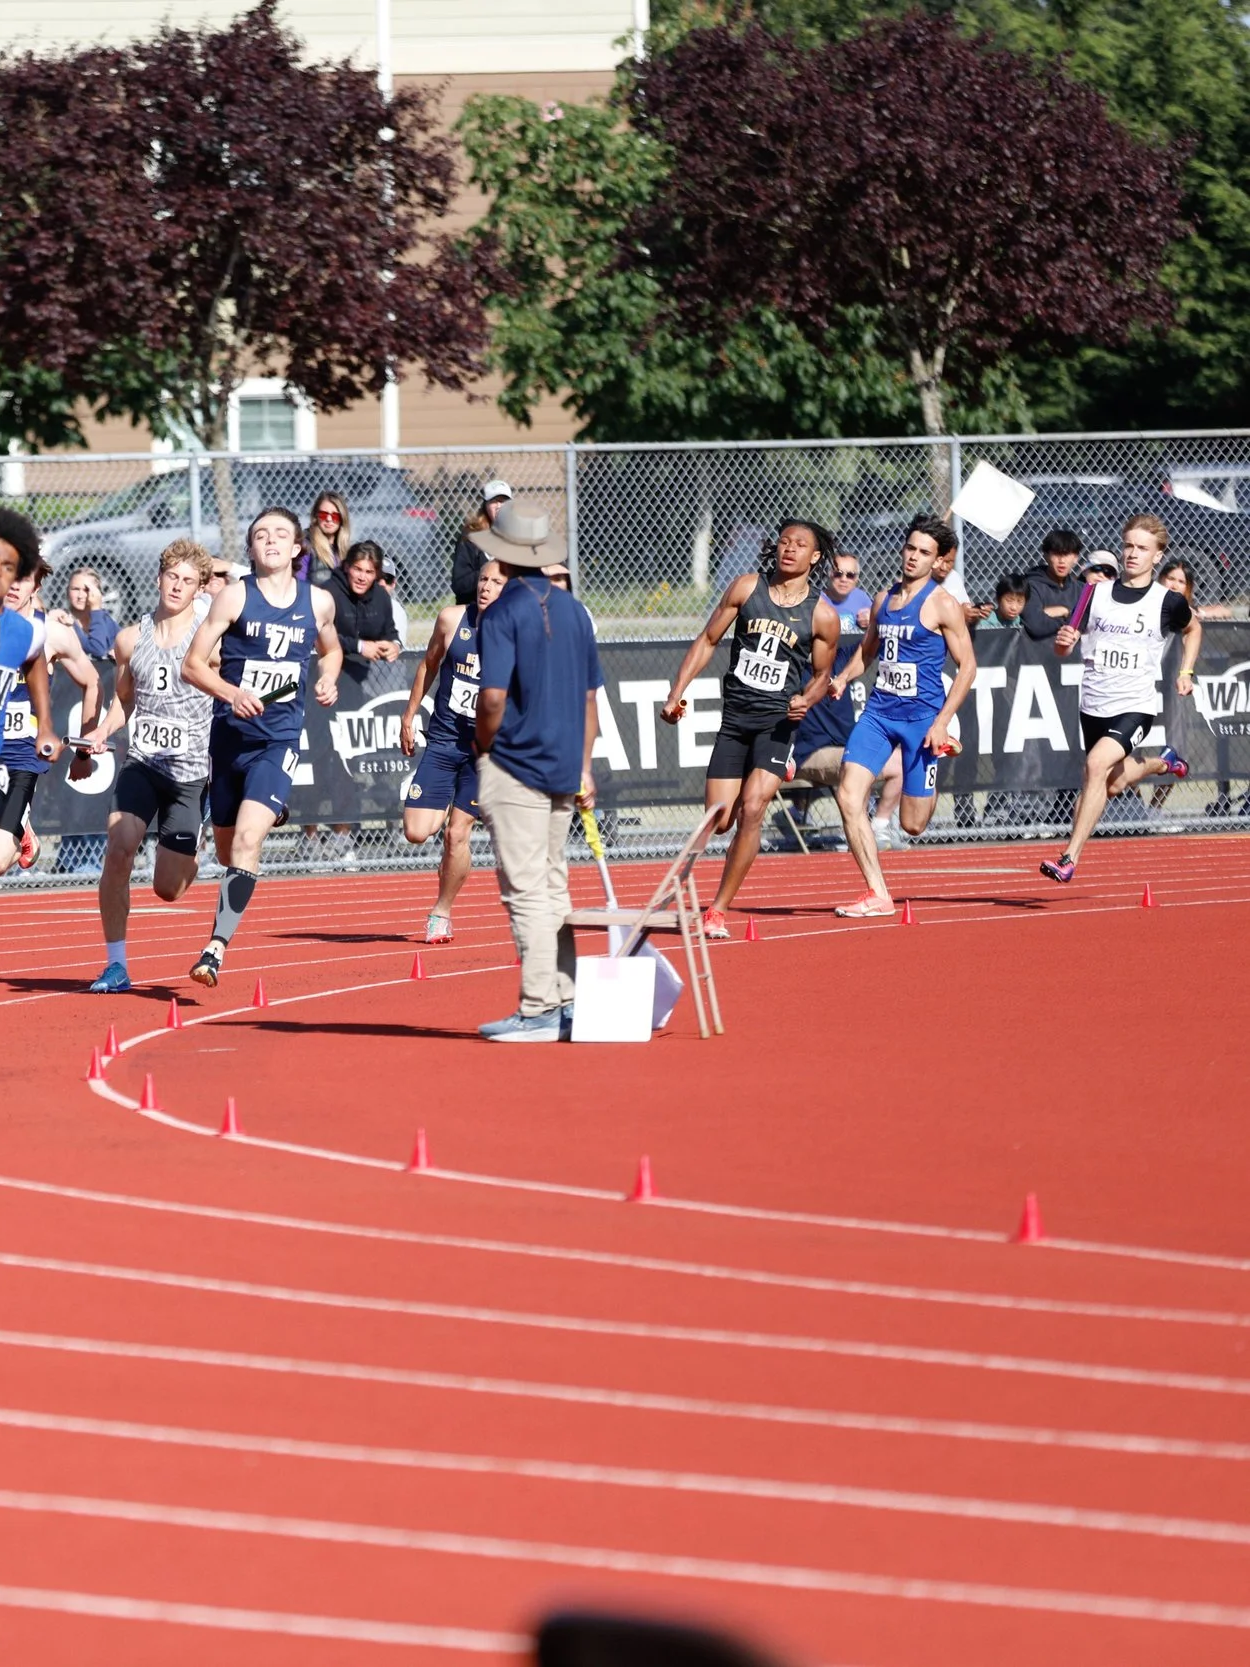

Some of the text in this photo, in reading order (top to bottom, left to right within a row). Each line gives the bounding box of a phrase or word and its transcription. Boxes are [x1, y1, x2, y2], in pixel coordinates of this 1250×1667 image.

[246, 622, 261, 637] MT
[748, 618, 798, 649] LINCOLN
[1134, 614, 1144, 633] 5
[276, 630, 285, 654] 7
[762, 638, 773, 655] 4
[887, 640, 894, 660] 8
[1102, 650, 1139, 669] 1051
[157, 667, 167, 690] 3
[744, 660, 781, 684] 1465
[142, 723, 181, 748] 2438
[928, 766, 936, 787] 8
